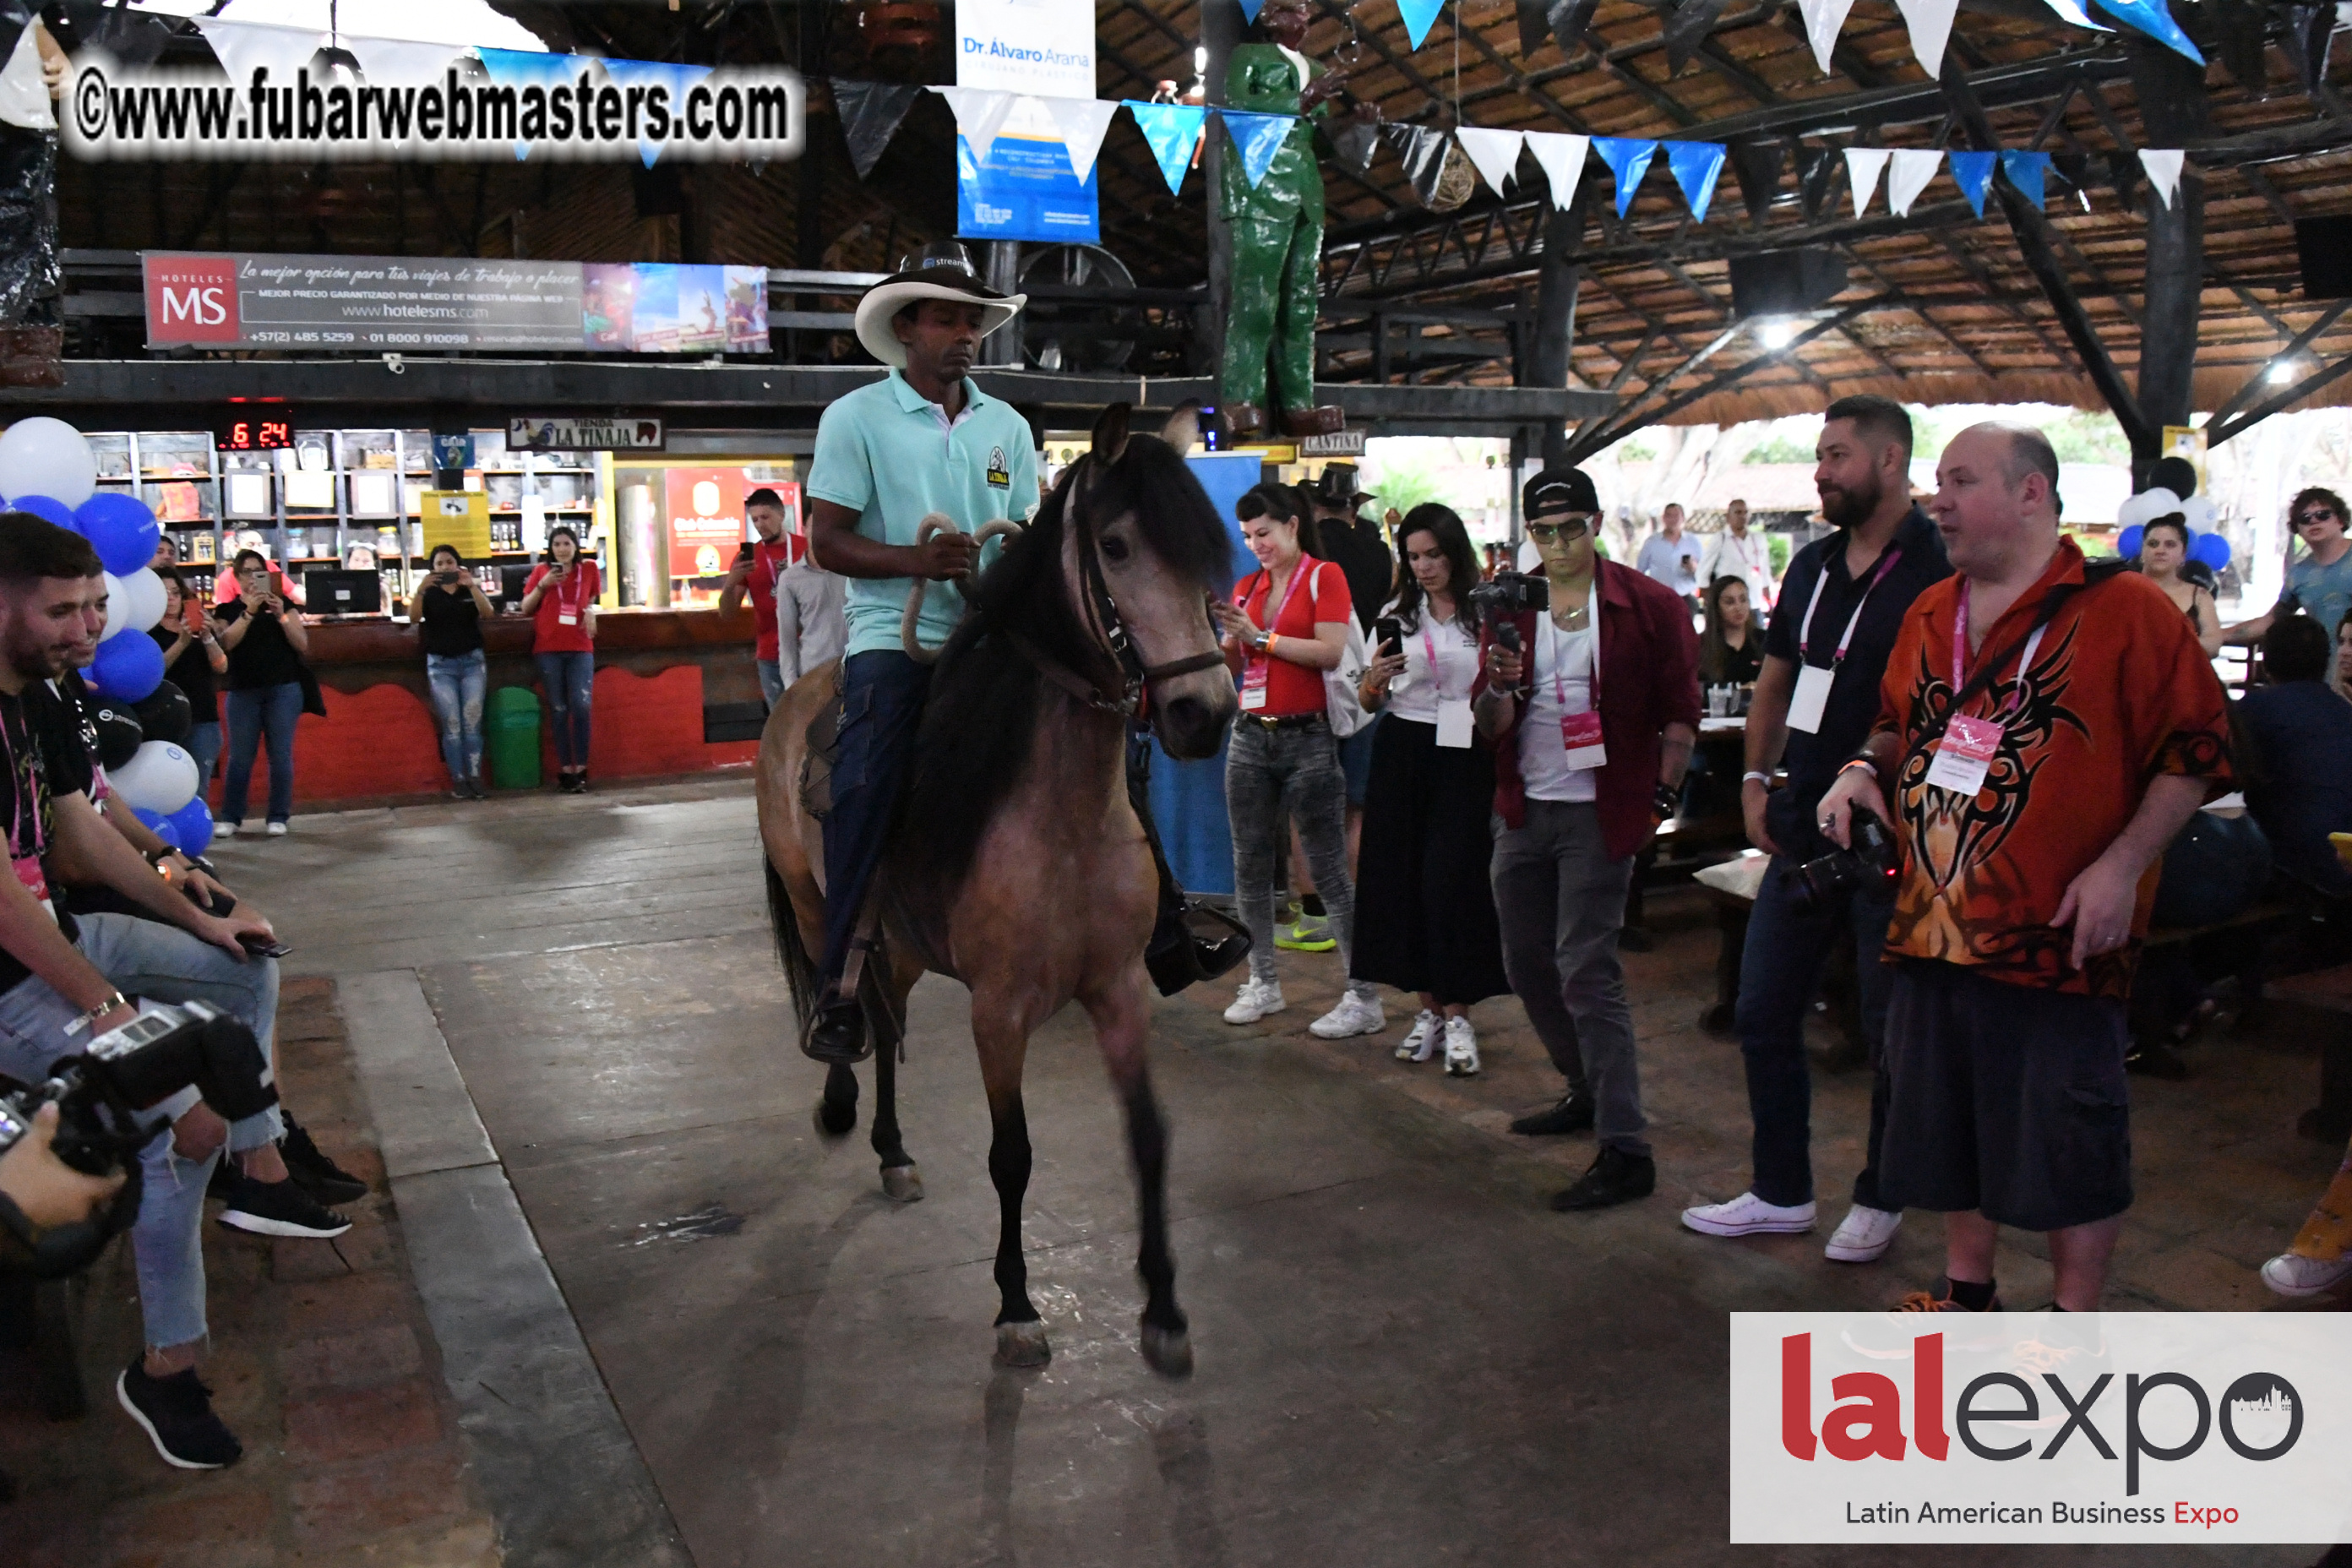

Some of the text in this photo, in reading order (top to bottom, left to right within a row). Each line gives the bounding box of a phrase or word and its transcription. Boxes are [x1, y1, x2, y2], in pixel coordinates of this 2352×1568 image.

[963, 36, 1090, 68] Dr. Álvaro Arana
[161, 274, 223, 284] HOTELES
[239, 259, 257, 279] La
[260, 265, 302, 284] mejor
[305, 266, 350, 285] opción
[349, 270, 384, 286] para
[412, 269, 450, 287] viajes
[455, 267, 471, 281] de
[475, 267, 522, 289] trabajo
[533, 270, 580, 290] placer
[162, 286, 226, 324] MS
[259, 289, 291, 297] MEJOR
[293, 289, 328, 298] PRECIO
[329, 290, 396, 300] GARANTIZADO
[399, 291, 418, 300] POR
[420, 292, 450, 301] MEDIO
[453, 292, 465, 301] DE
[467, 293, 509, 302] NUESTRA
[544, 295, 564, 303] WEB
[341, 304, 489, 318] www.hotelesms.com
[250, 331, 354, 342] +57(2) 485 5259
[370, 333, 469, 344] 01 8000 910098
[233, 422, 287, 443] 6 24
[556, 428, 632, 446] LA TINAJA
[1304, 432, 1364, 452] CANTINA
